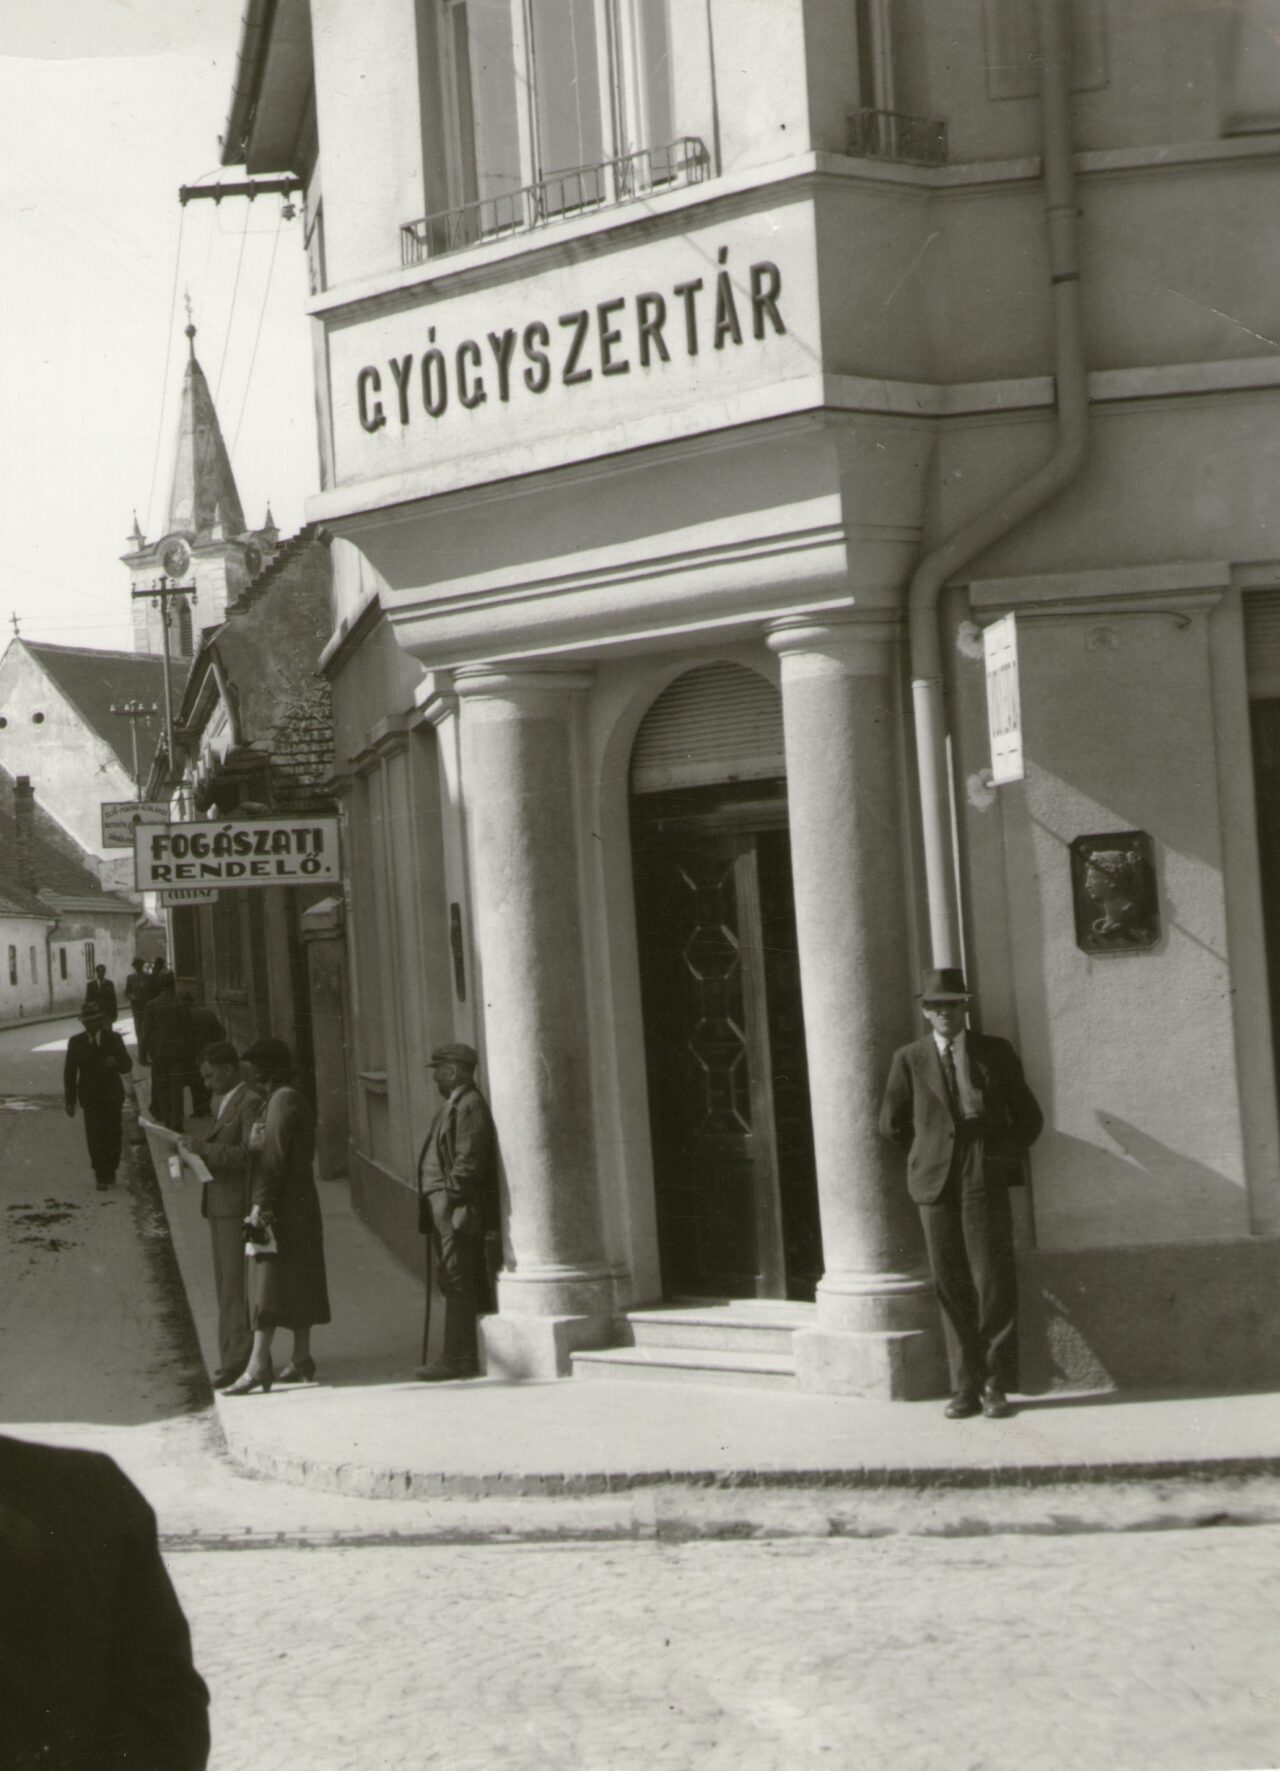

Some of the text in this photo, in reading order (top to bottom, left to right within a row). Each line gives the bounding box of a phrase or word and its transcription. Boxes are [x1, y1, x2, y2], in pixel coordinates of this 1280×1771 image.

[356, 245, 788, 434] GYÓGYSZERTÁR
[150, 823, 324, 861] FOGÁSZATI
[150, 852, 332, 882] RENDELŐ.
